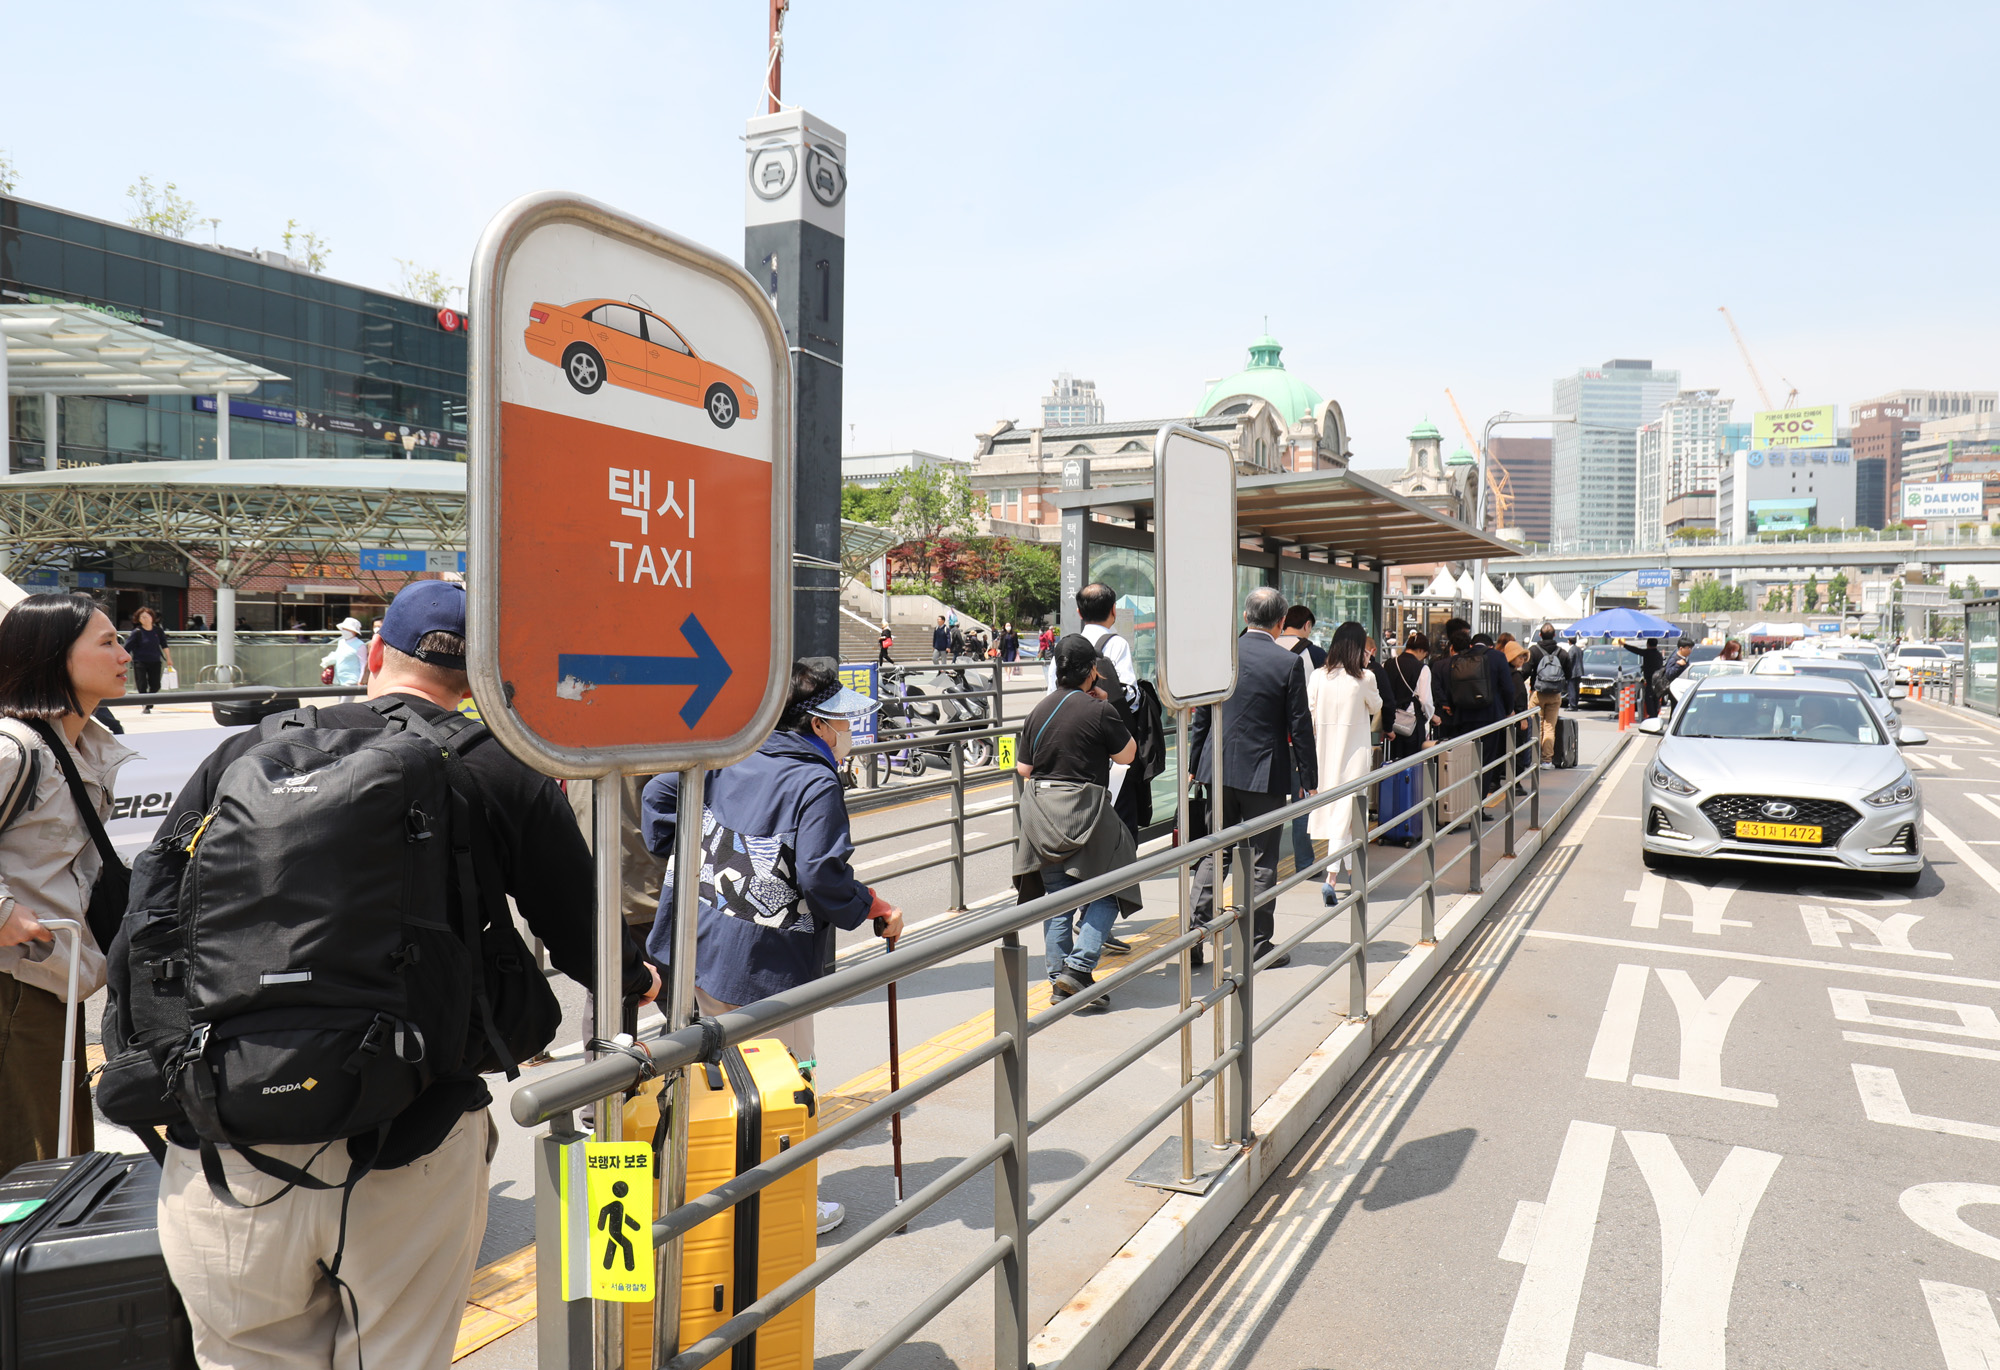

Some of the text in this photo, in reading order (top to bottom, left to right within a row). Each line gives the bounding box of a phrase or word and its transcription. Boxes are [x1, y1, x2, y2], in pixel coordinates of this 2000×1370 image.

[1065, 478, 1080, 487] TAXI
[608, 466, 695, 539] 택시
[1924, 492, 1979, 503] DAEWON
[609, 540, 692, 589] TAXI
[272, 785, 319, 794] SKYSPER
[262, 1082, 302, 1095] BOGDA
[588, 1154, 648, 1169] 보행자 보호
[611, 1283, 647, 1292] 서울경찰청
